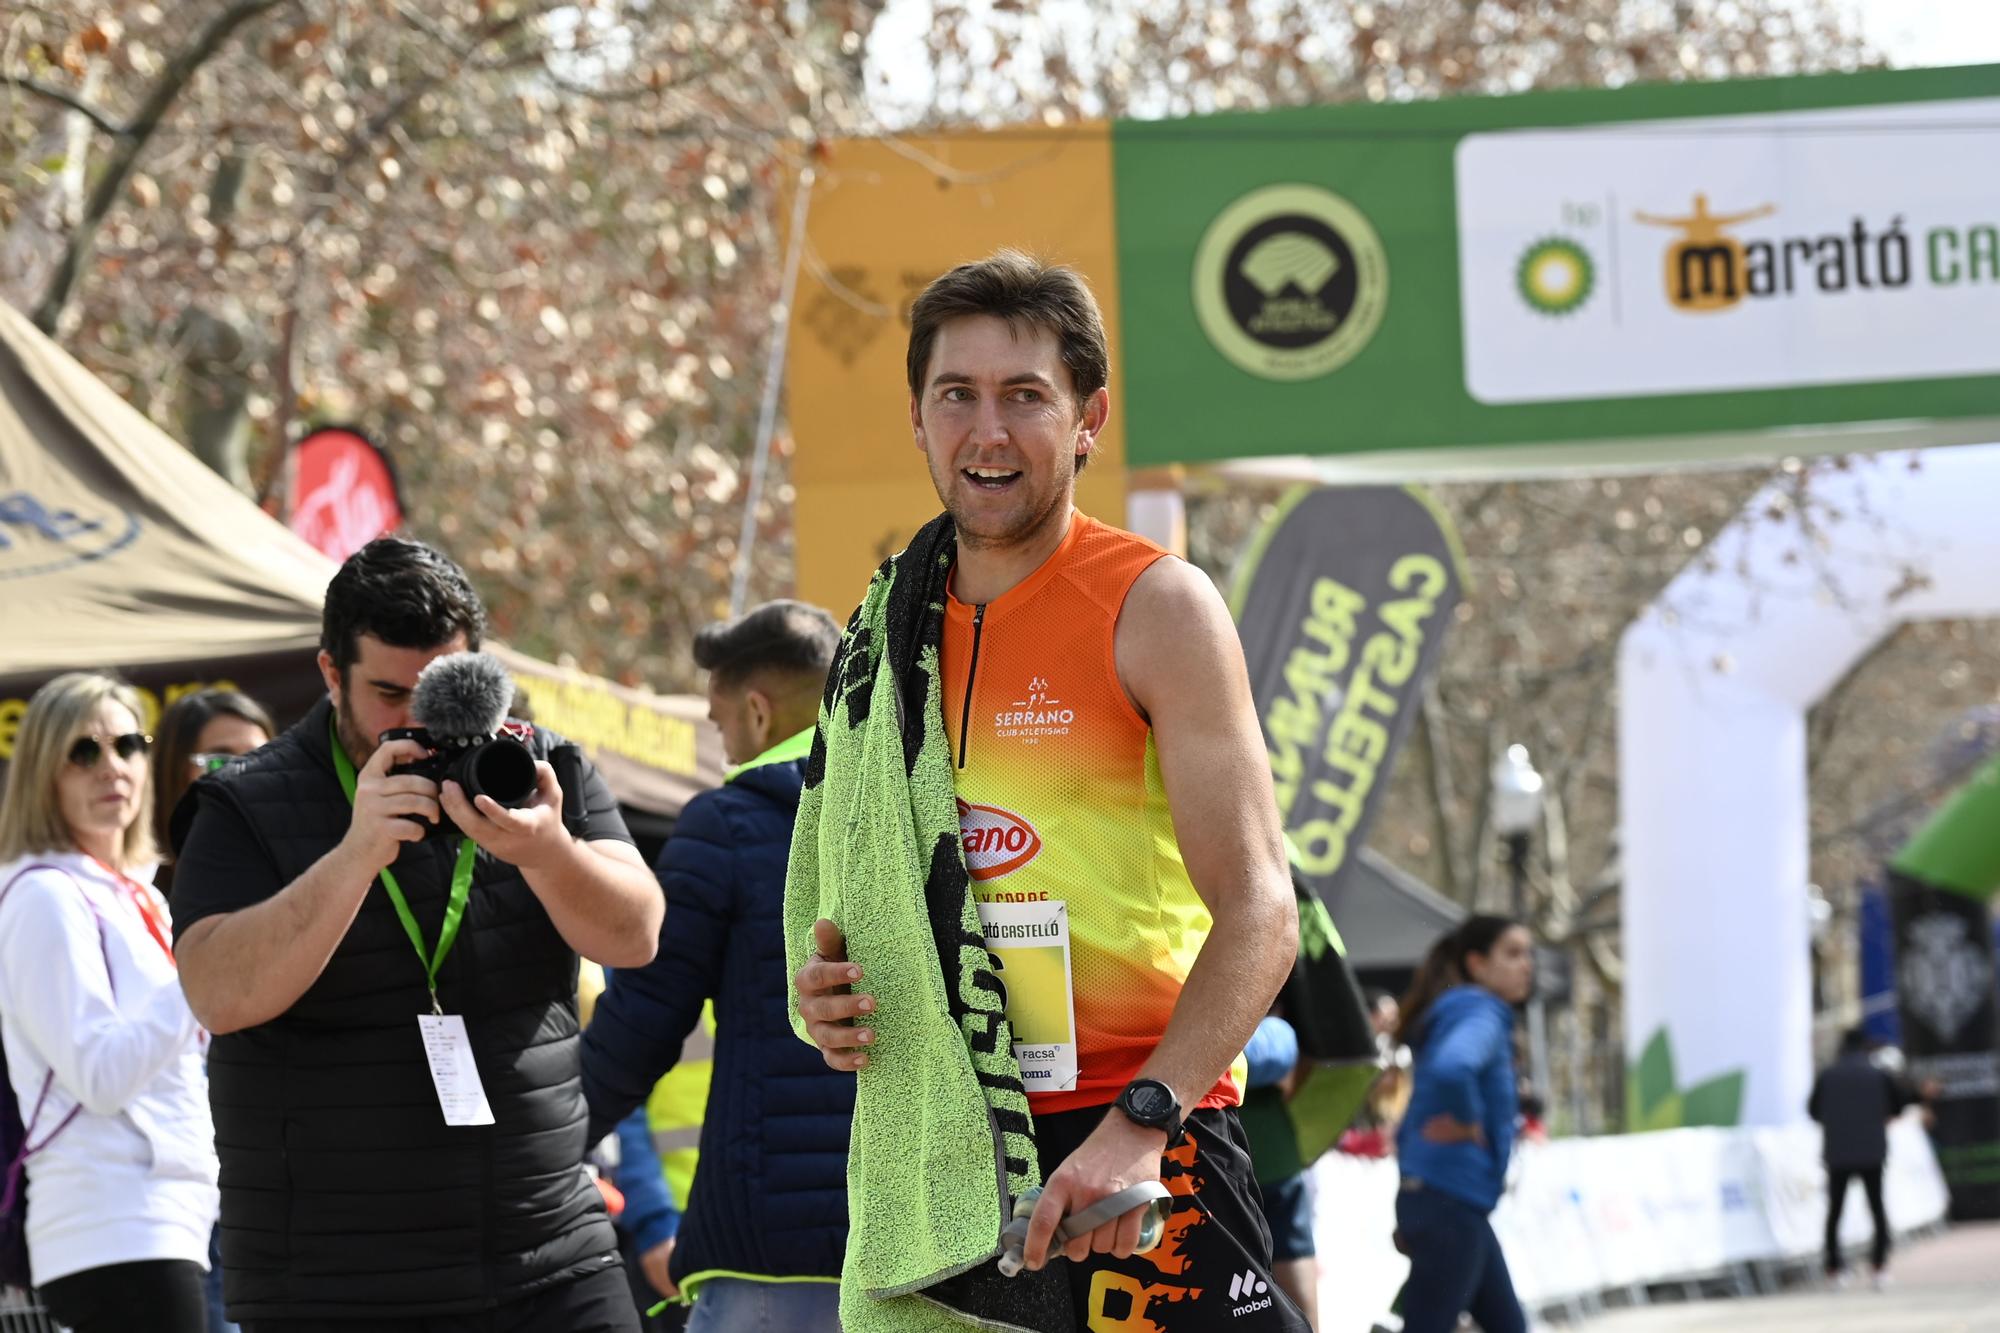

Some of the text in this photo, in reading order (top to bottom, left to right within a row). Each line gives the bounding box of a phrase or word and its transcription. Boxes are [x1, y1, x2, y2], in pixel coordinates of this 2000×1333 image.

[1676, 213, 1912, 304] marató
[994, 708, 1074, 727] SERRANO
[996, 729, 1018, 737] CLUB
[1001, 919, 1059, 939] CASTELLÓ
[1233, 1295, 1272, 1318] mobel
